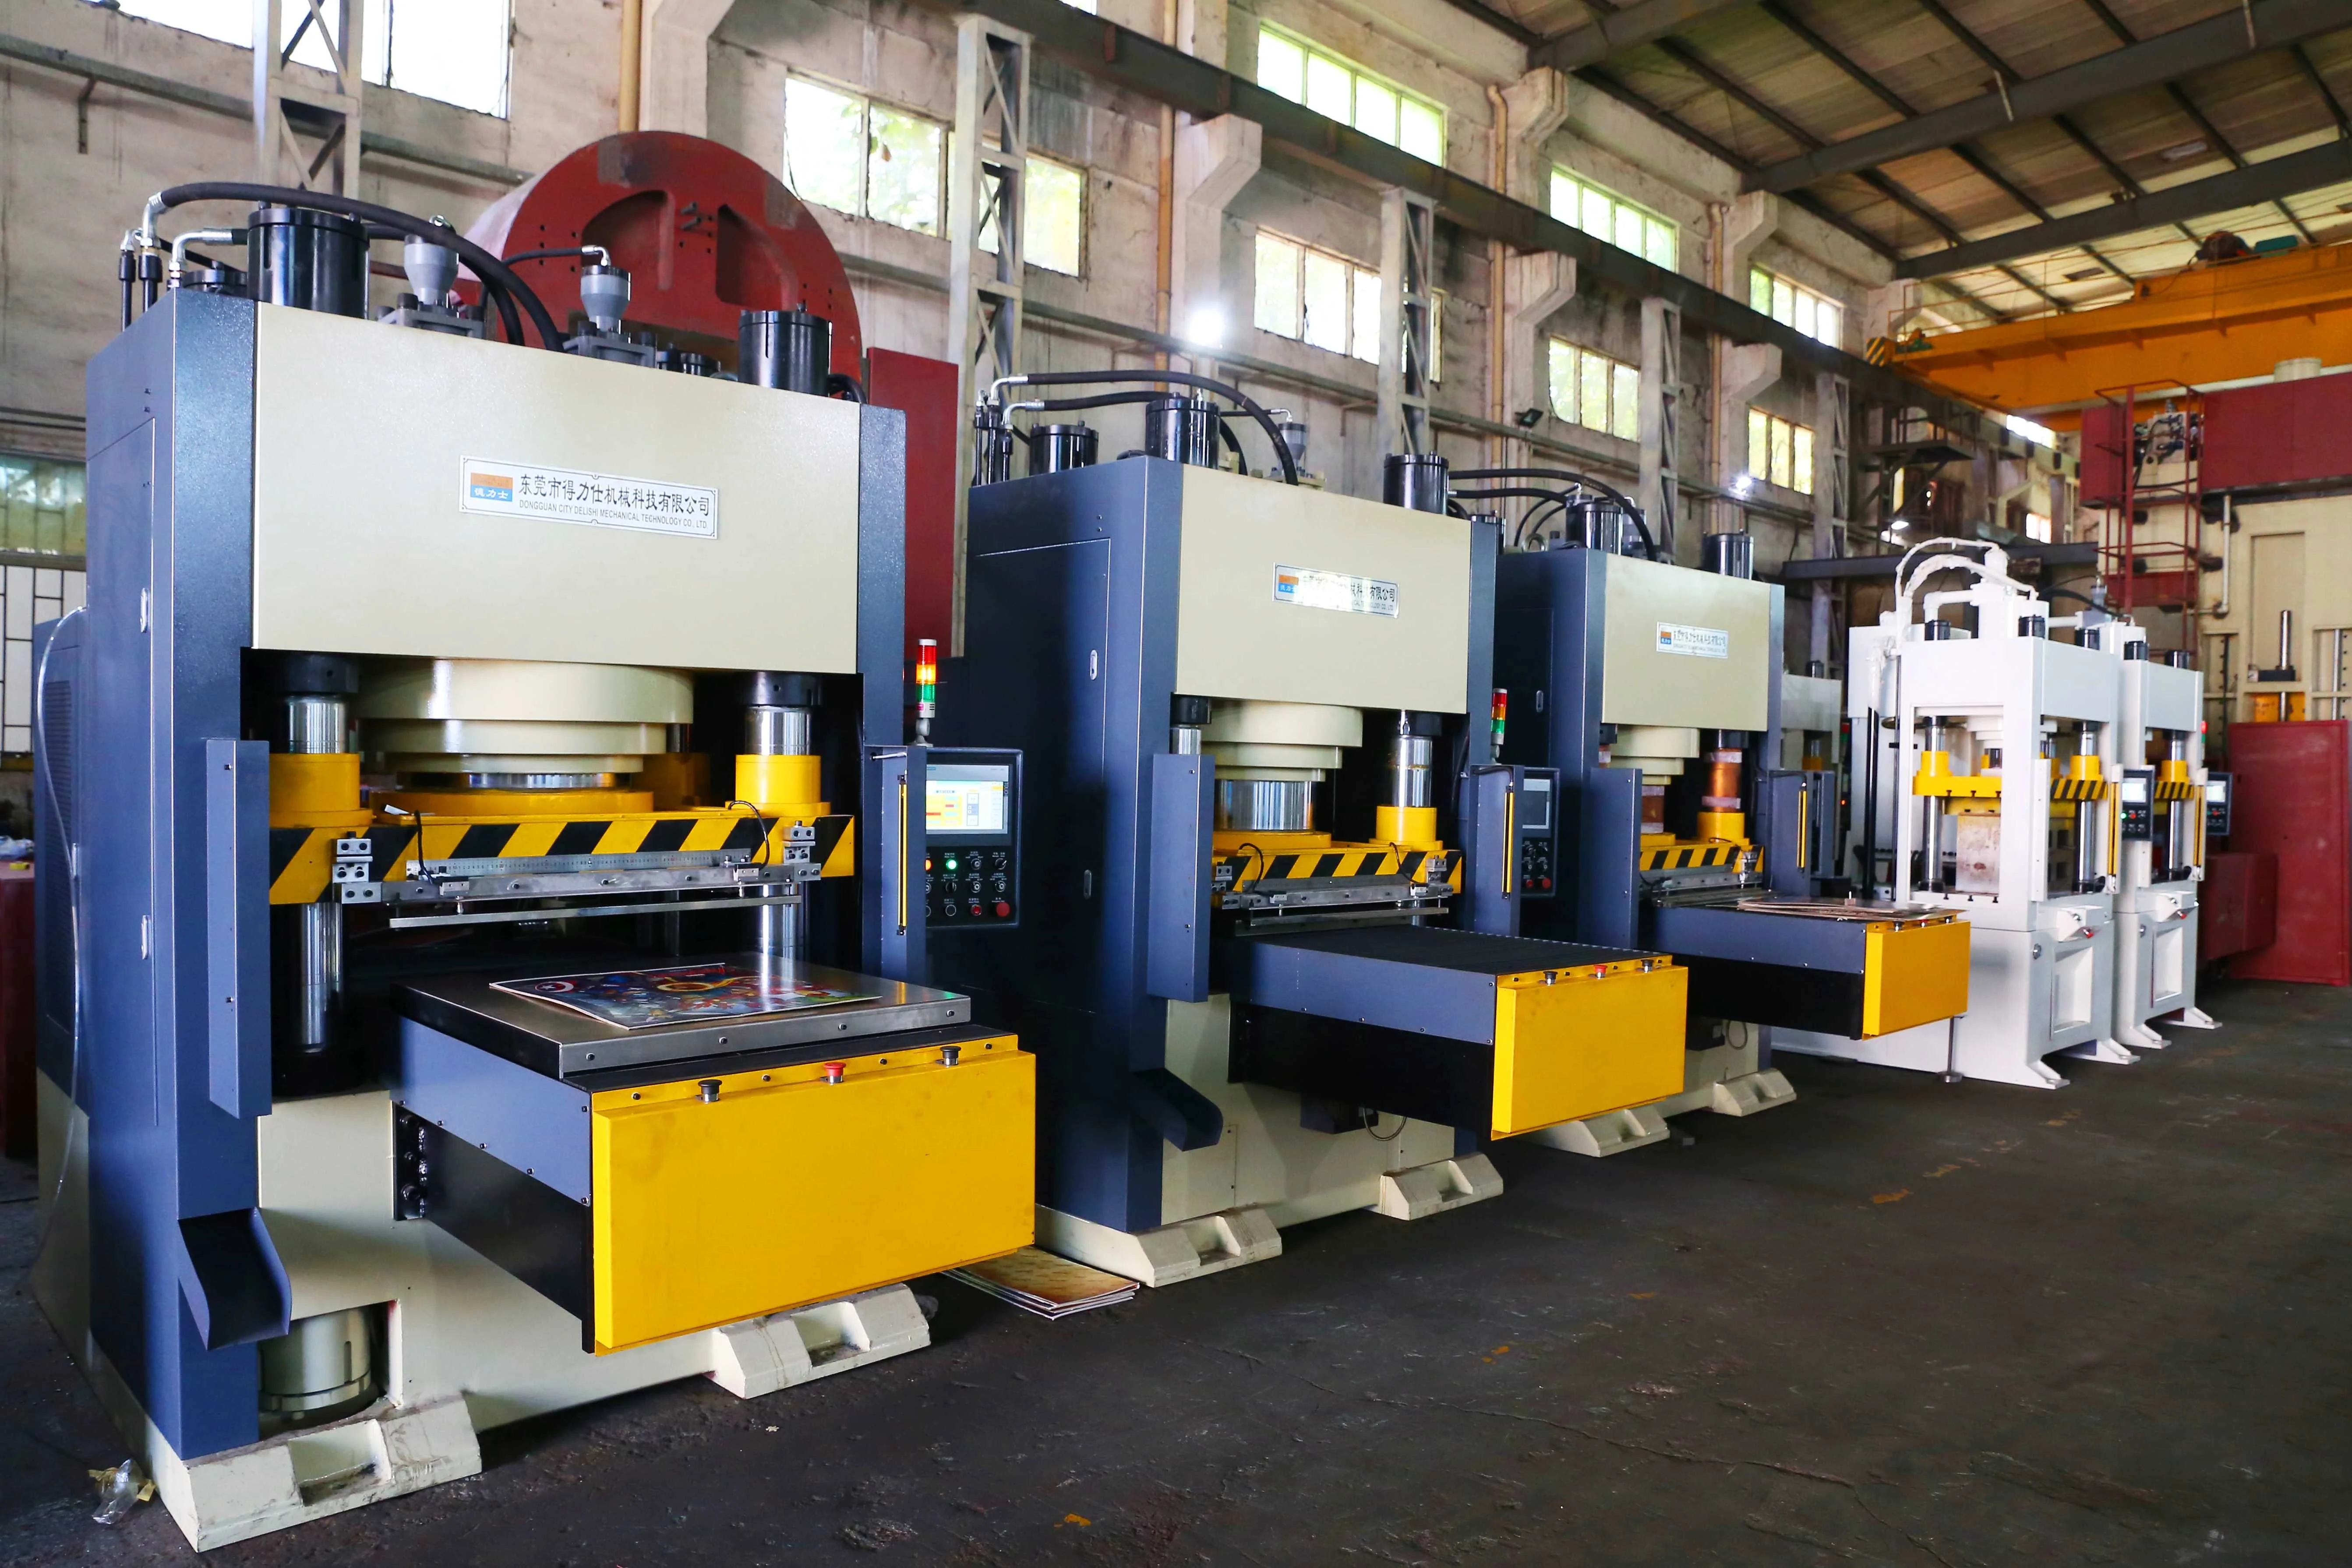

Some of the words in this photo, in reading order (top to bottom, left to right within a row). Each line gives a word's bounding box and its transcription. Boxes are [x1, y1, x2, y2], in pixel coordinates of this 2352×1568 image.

[519, 474, 709, 516] 东莞市得力仕机械科技有限公司
[519, 500, 557, 512] DONGGUAN
[558, 504, 572, 513] CITY
[574, 506, 599, 516] DELISHI
[600, 509, 639, 521] MECHANICAL
[642, 514, 682, 526] TECHNOLOGY
